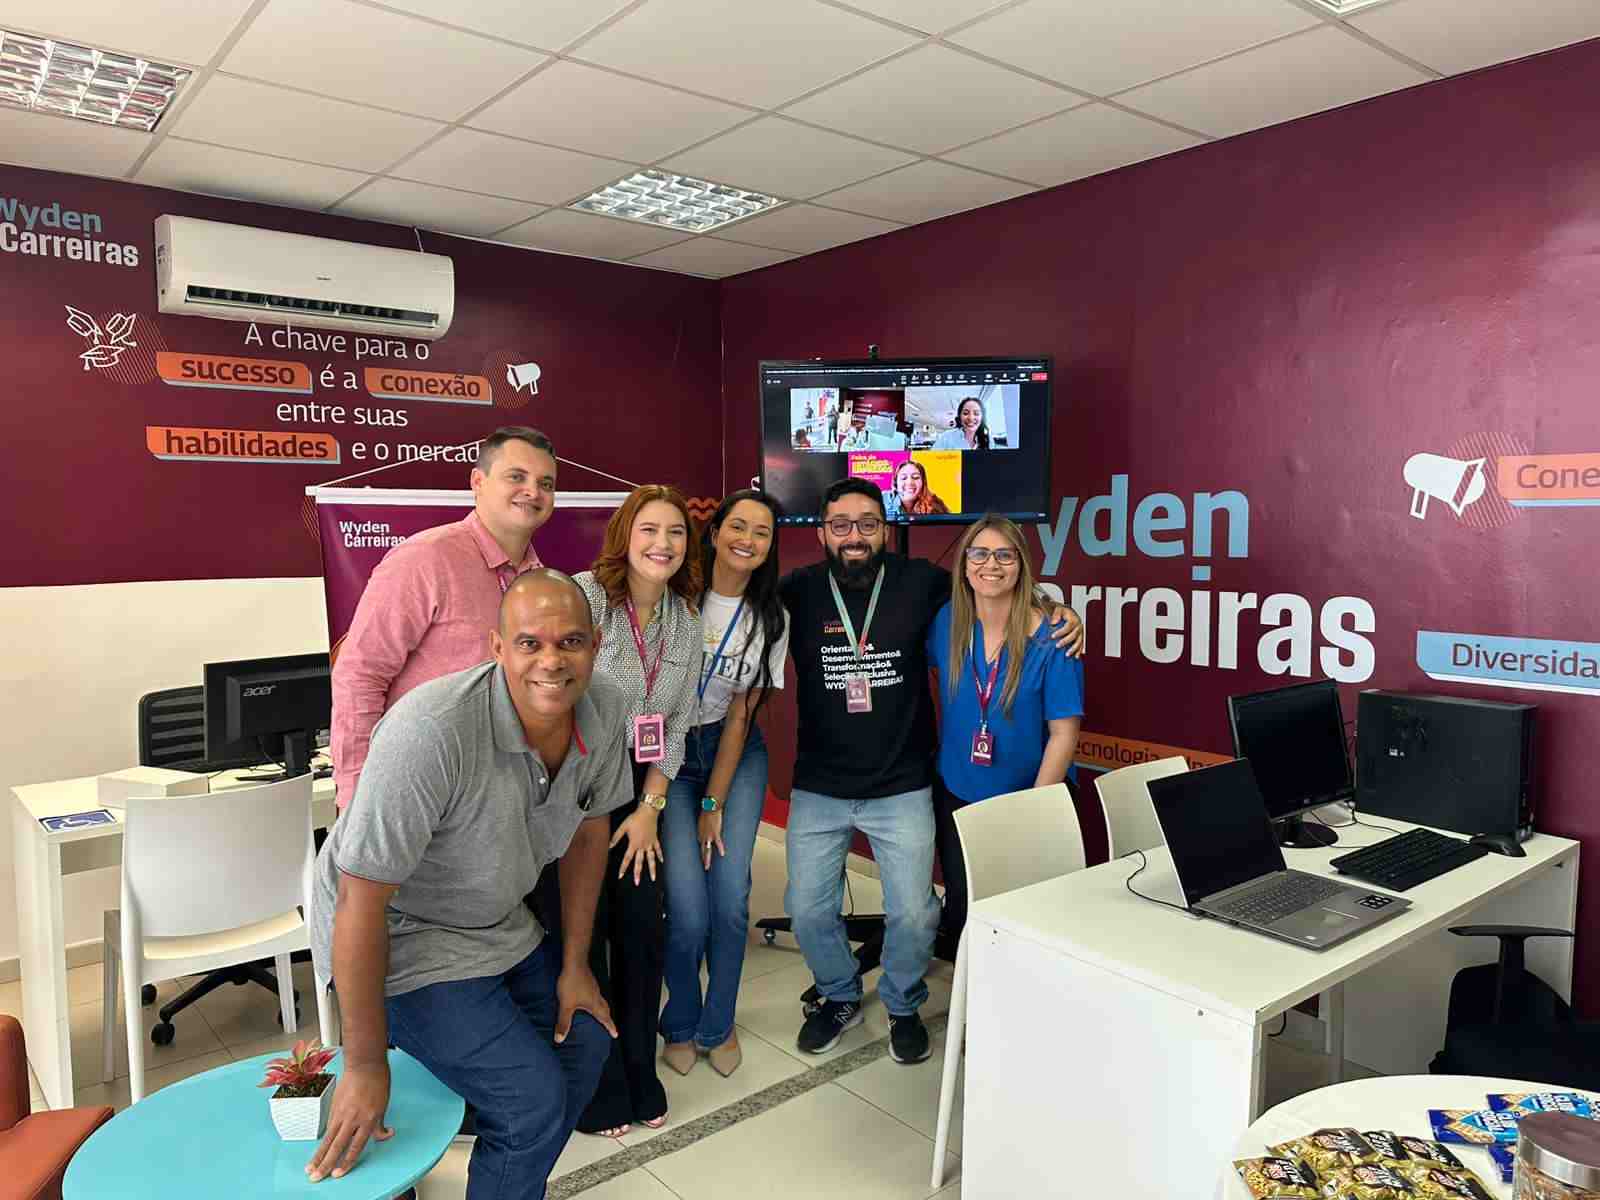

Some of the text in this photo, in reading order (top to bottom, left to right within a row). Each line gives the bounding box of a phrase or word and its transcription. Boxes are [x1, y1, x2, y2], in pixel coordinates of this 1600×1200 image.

[0, 198, 101, 233] Wyden
[0, 222, 139, 267] Carreiras
[244, 322, 430, 361] A chave para o
[180, 359, 481, 398] sucesso é a conexão
[276, 401, 409, 427] entre suas
[165, 429, 480, 463] habilidades e o mercad
[1517, 464, 1600, 489] Cone
[339, 520, 390, 535] Wyden
[1036, 474, 1250, 576] yden
[1036, 565, 1377, 683] rreiras
[820, 643, 875, 655] Orienta&
[821, 649, 902, 663] Desenvvimento&
[1452, 642, 1600, 678] Diversida
[243, 684, 277, 697] acer
[1074, 741, 1160, 766] ecnologi
